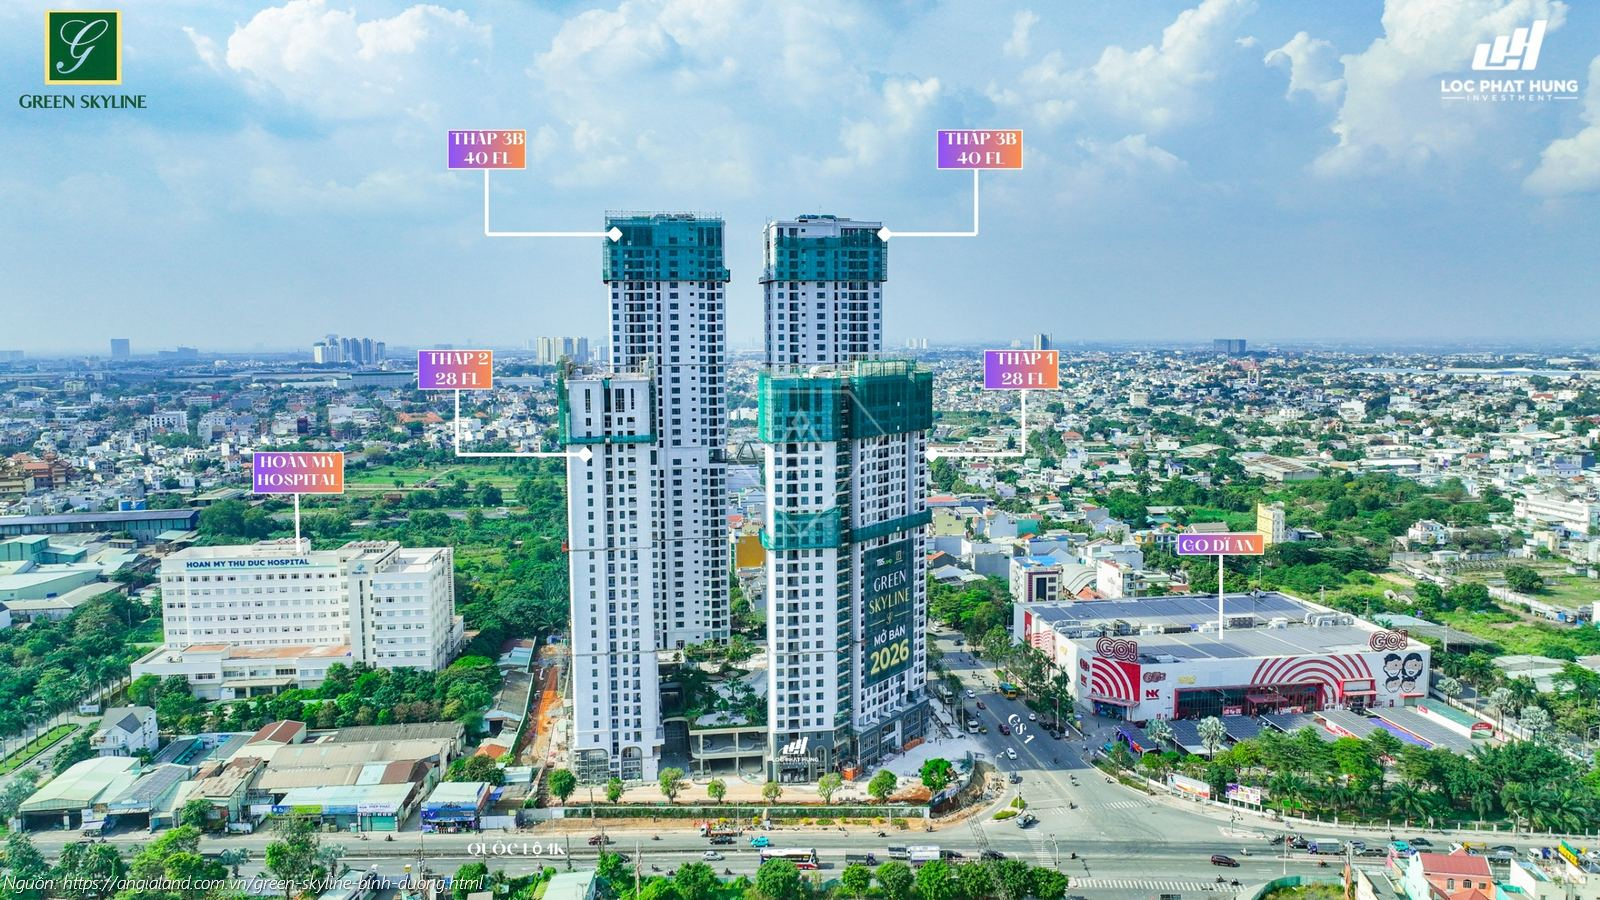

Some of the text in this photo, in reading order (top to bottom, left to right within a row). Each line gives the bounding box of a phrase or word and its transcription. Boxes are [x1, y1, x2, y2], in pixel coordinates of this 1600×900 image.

[248, 559, 265, 567] DUC
[267, 558, 310, 566] HOSPITAL
[873, 569, 907, 592] GREEN
[868, 587, 911, 615] SKYLINE
[874, 624, 906, 647] MỞ BÁN
[1369, 630, 1408, 652] GO!
[869, 638, 910, 675] 2026
[1096, 636, 1138, 662] GO!
